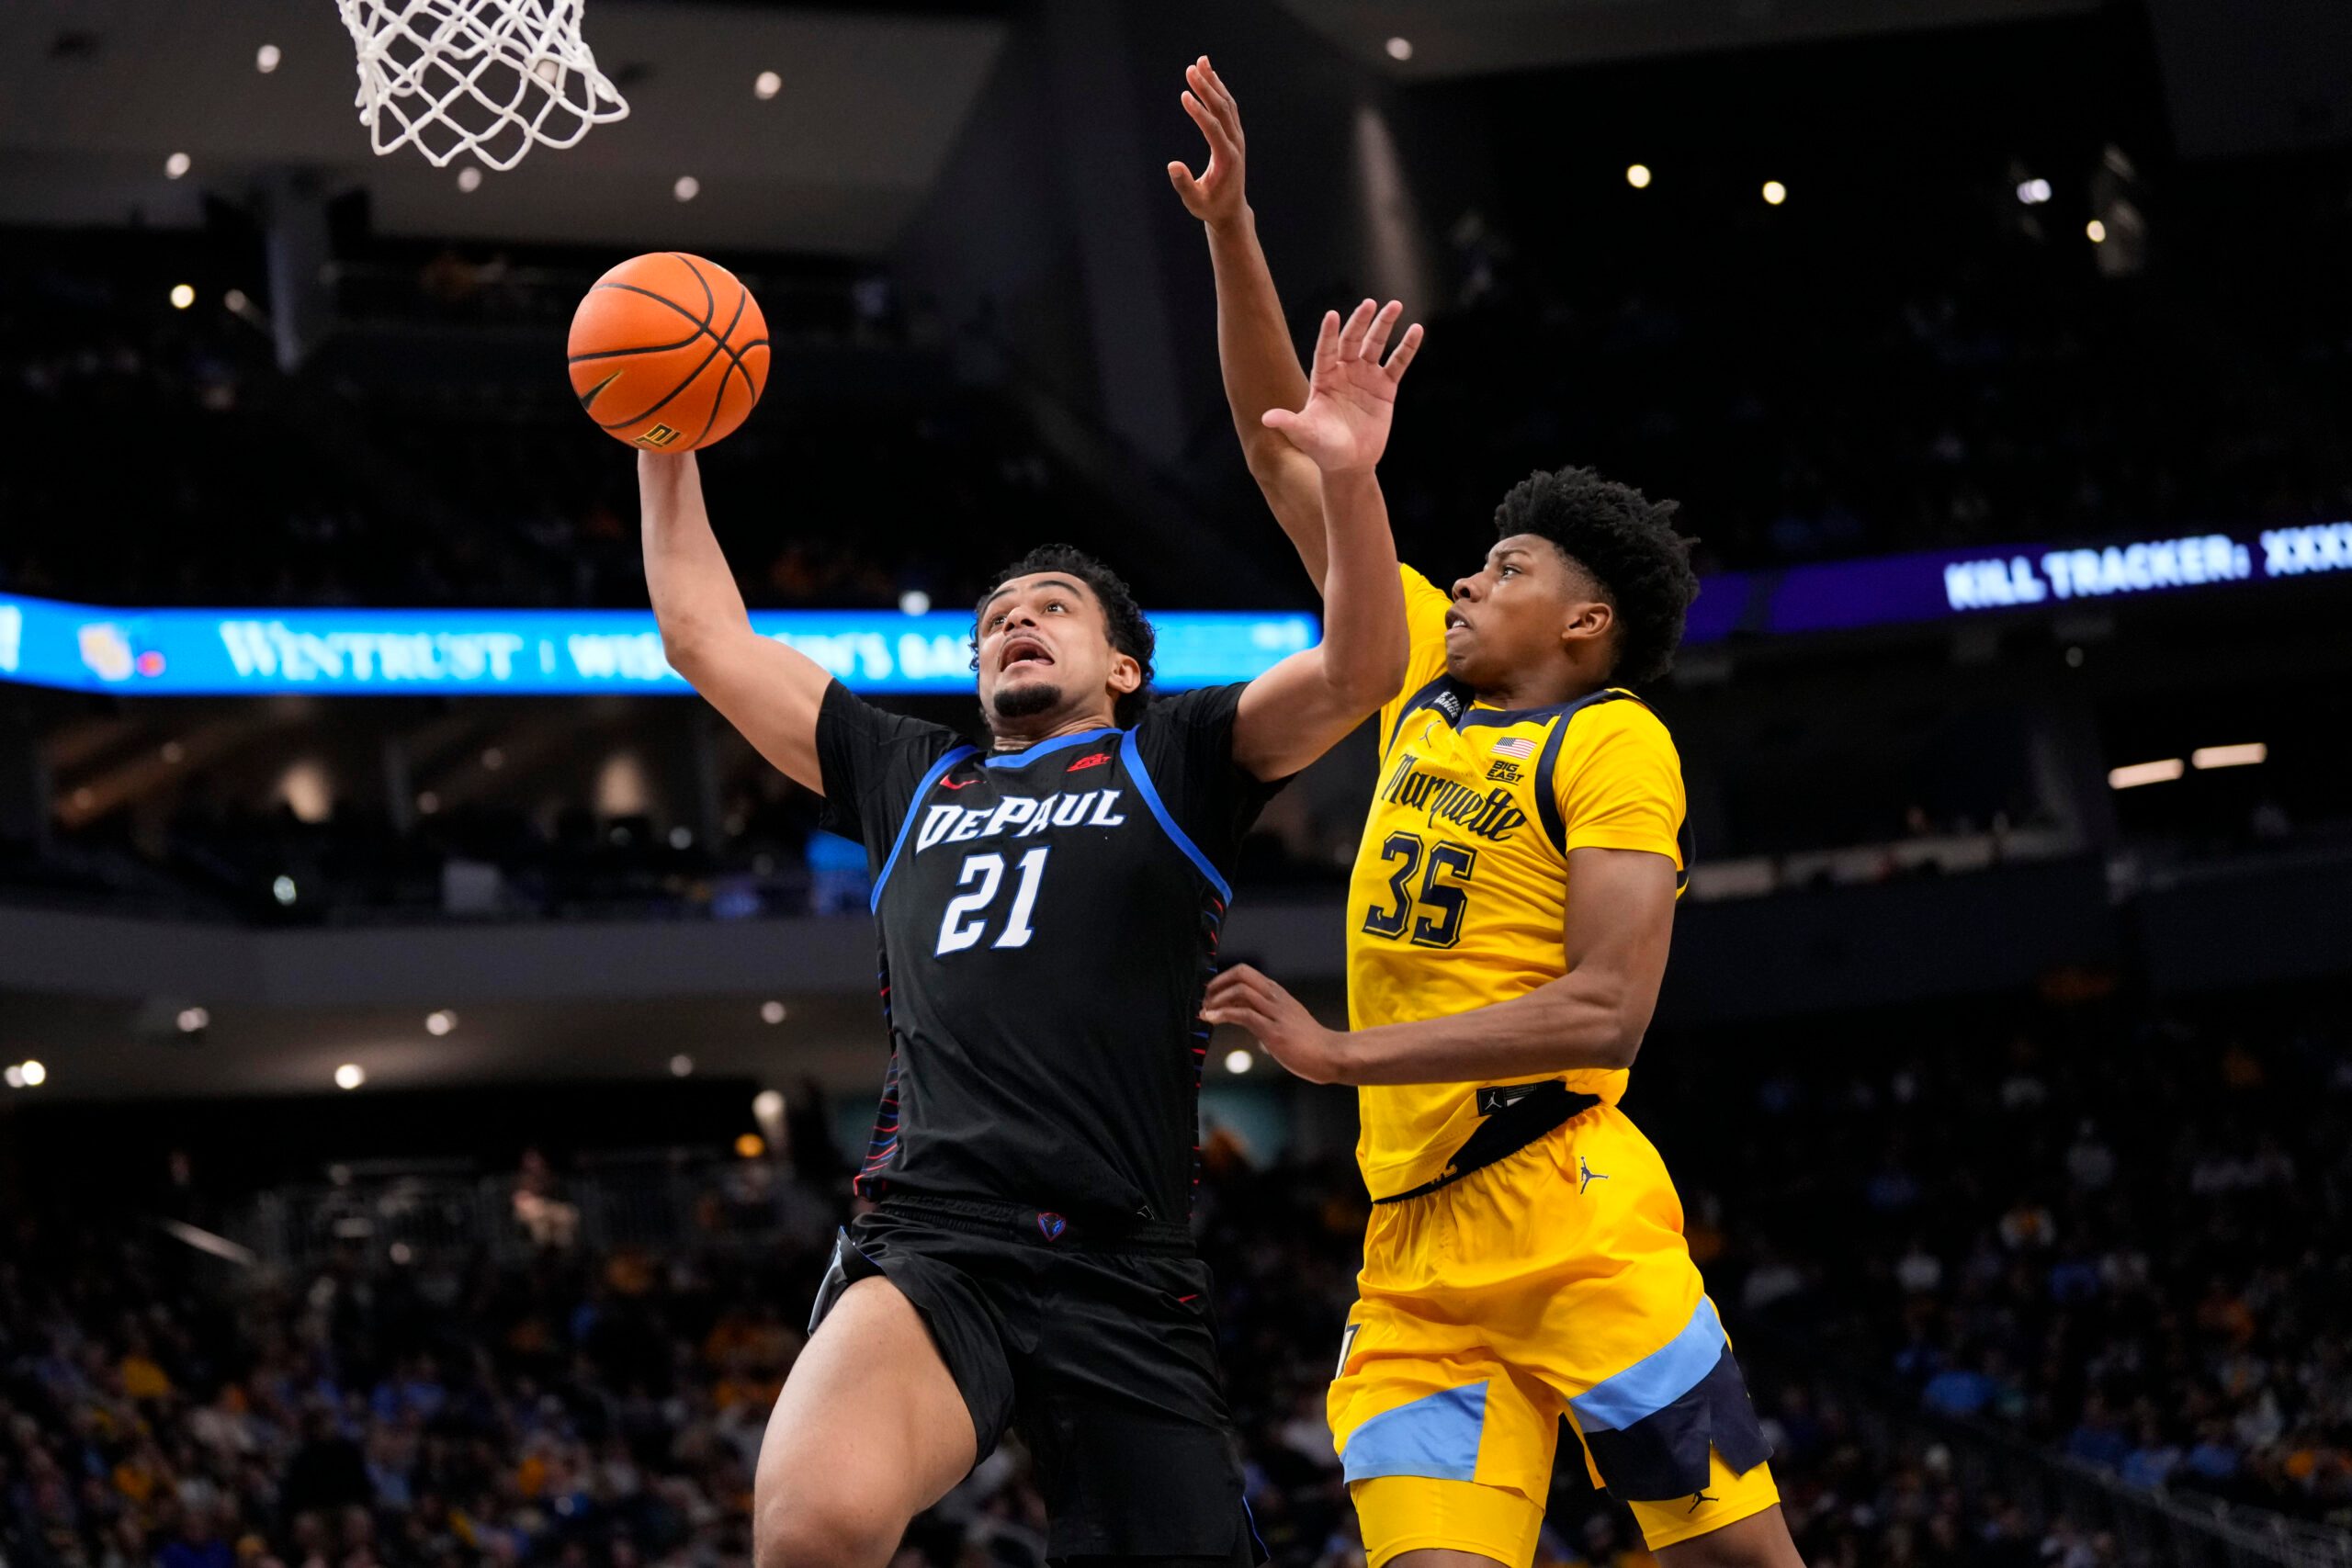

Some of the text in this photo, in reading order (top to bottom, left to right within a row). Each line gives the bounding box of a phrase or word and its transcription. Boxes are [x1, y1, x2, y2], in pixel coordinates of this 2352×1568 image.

[1943, 555, 2047, 610] KILL
[219, 621, 523, 680] WINTRUST
[1487, 768, 1524, 782] EAST
[1492, 760, 1520, 773] BIG
[1381, 753, 1527, 841] Marquette
[933, 845, 1052, 957] 21
[1362, 830, 1477, 949] 35
